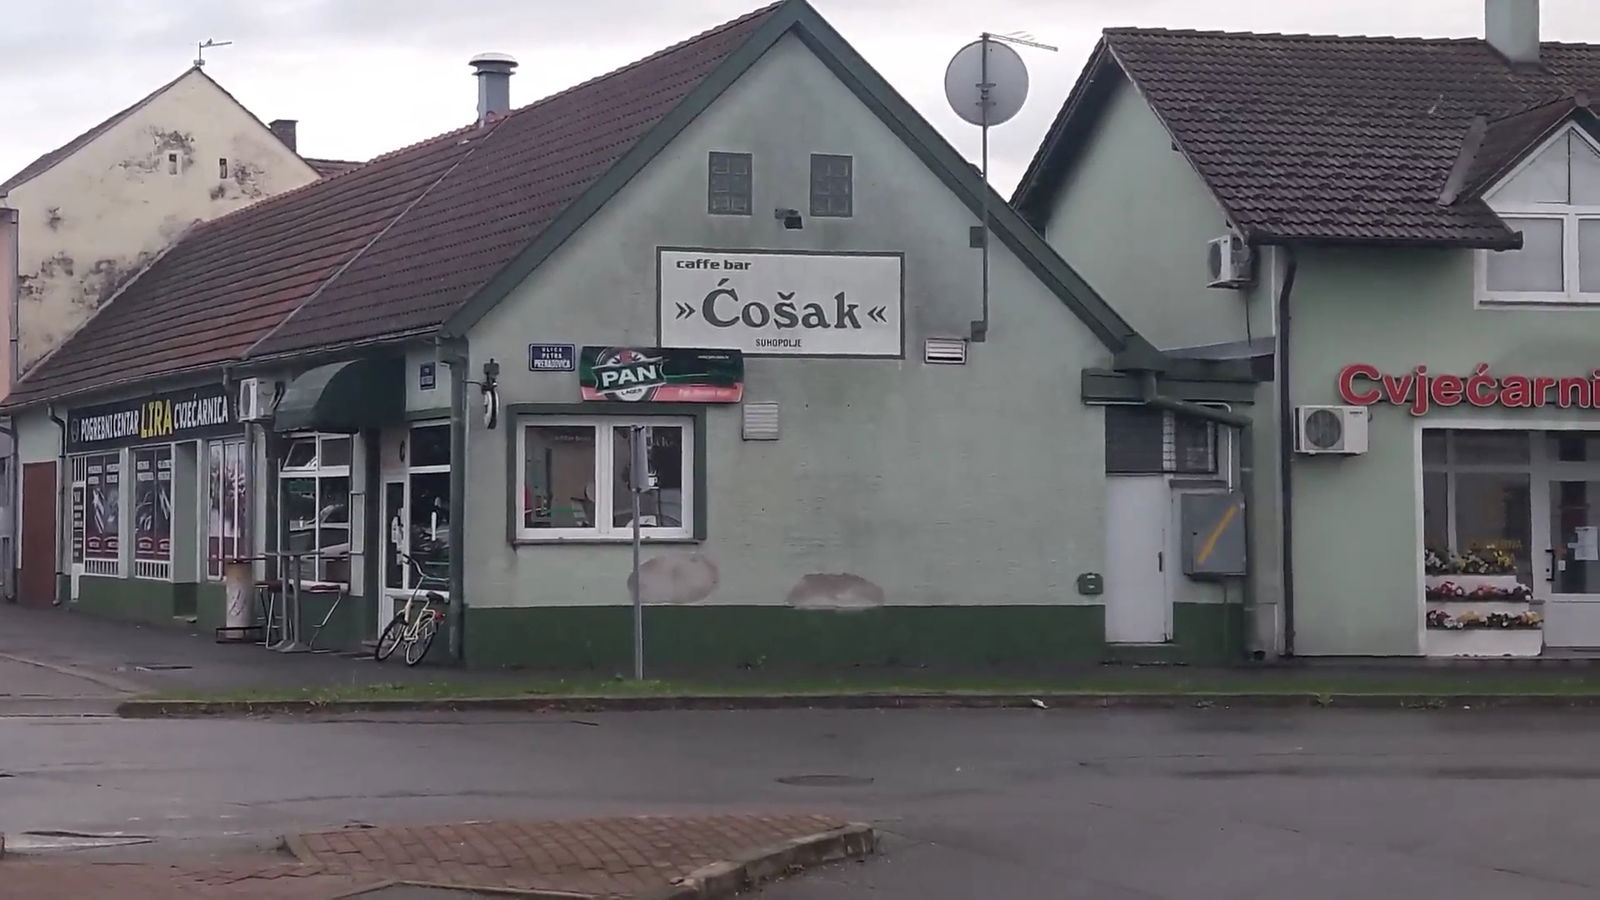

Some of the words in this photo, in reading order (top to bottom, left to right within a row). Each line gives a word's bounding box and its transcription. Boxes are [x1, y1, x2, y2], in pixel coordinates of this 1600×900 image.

[676, 259, 720, 270] caffe
[724, 259, 751, 270] bar
[755, 338, 802, 348] SUHOPOLJE
[601, 364, 657, 388] PAN
[620, 388, 643, 396] LAGER
[80, 415, 113, 442] POGREBNI
[113, 410, 139, 438] CENTAR
[141, 399, 173, 439] LIRA
[173, 393, 229, 430] CVJEĆARNICA
